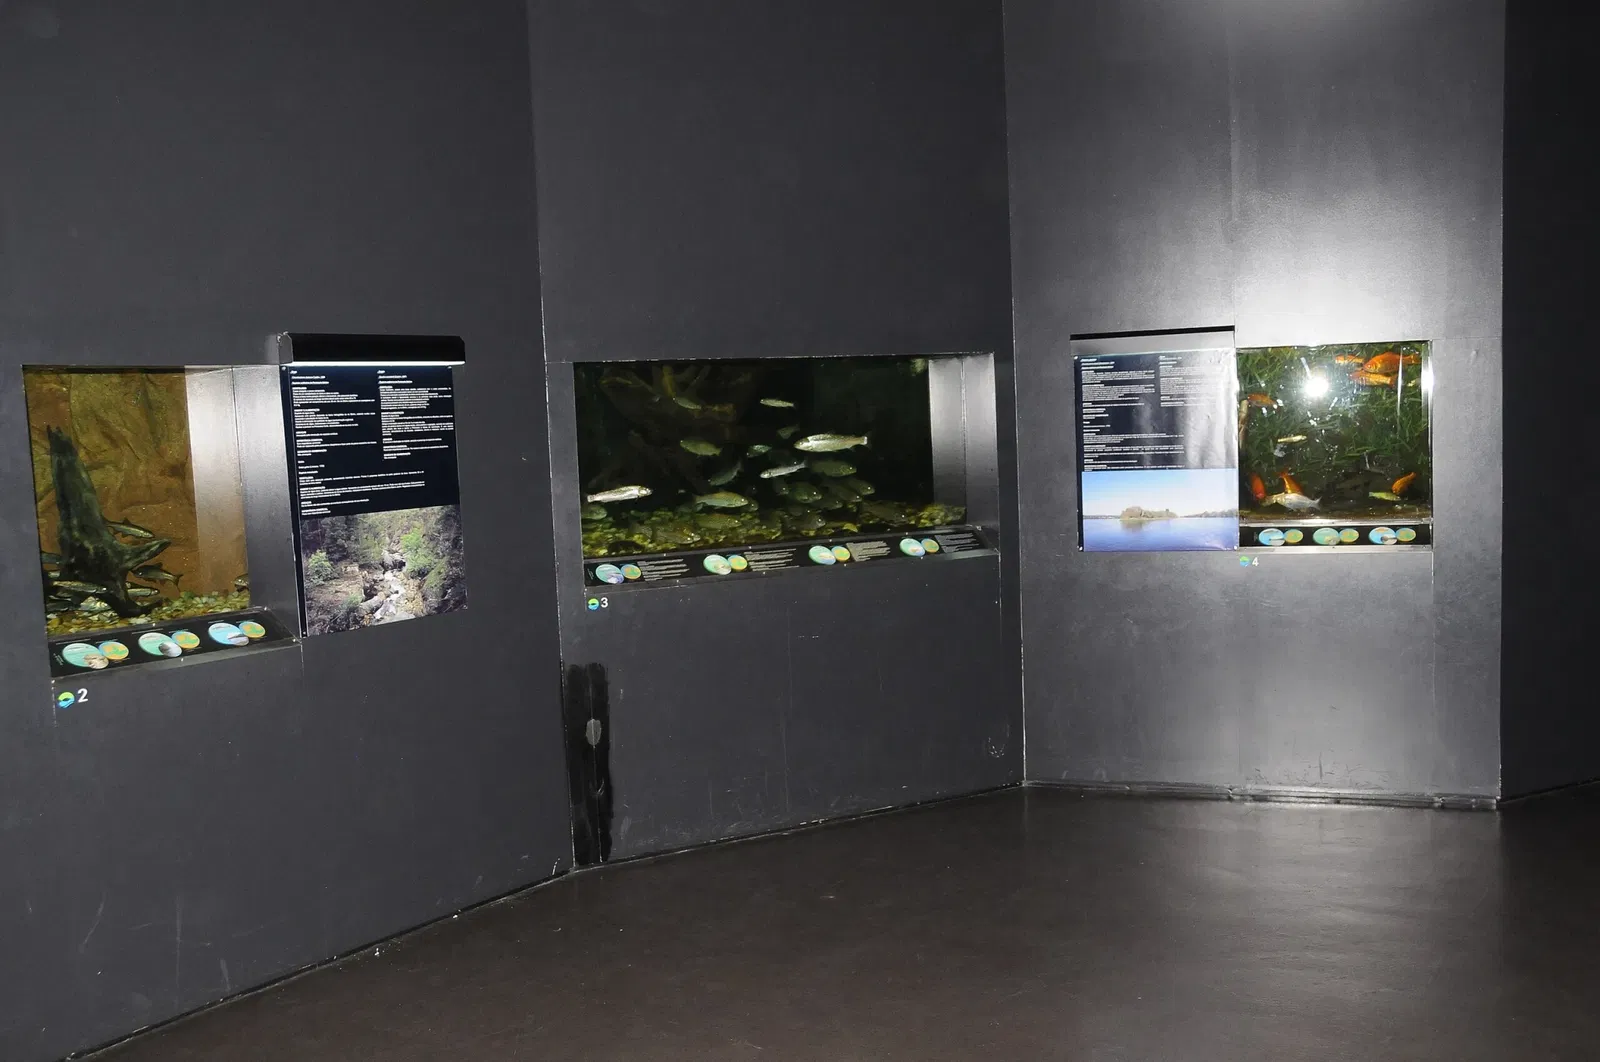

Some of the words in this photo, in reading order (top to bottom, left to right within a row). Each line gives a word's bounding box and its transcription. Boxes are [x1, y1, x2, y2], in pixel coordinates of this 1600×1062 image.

[1252, 556, 1259, 566] 4
[600, 597, 609, 608] 3
[77, 688, 88, 703] 2
